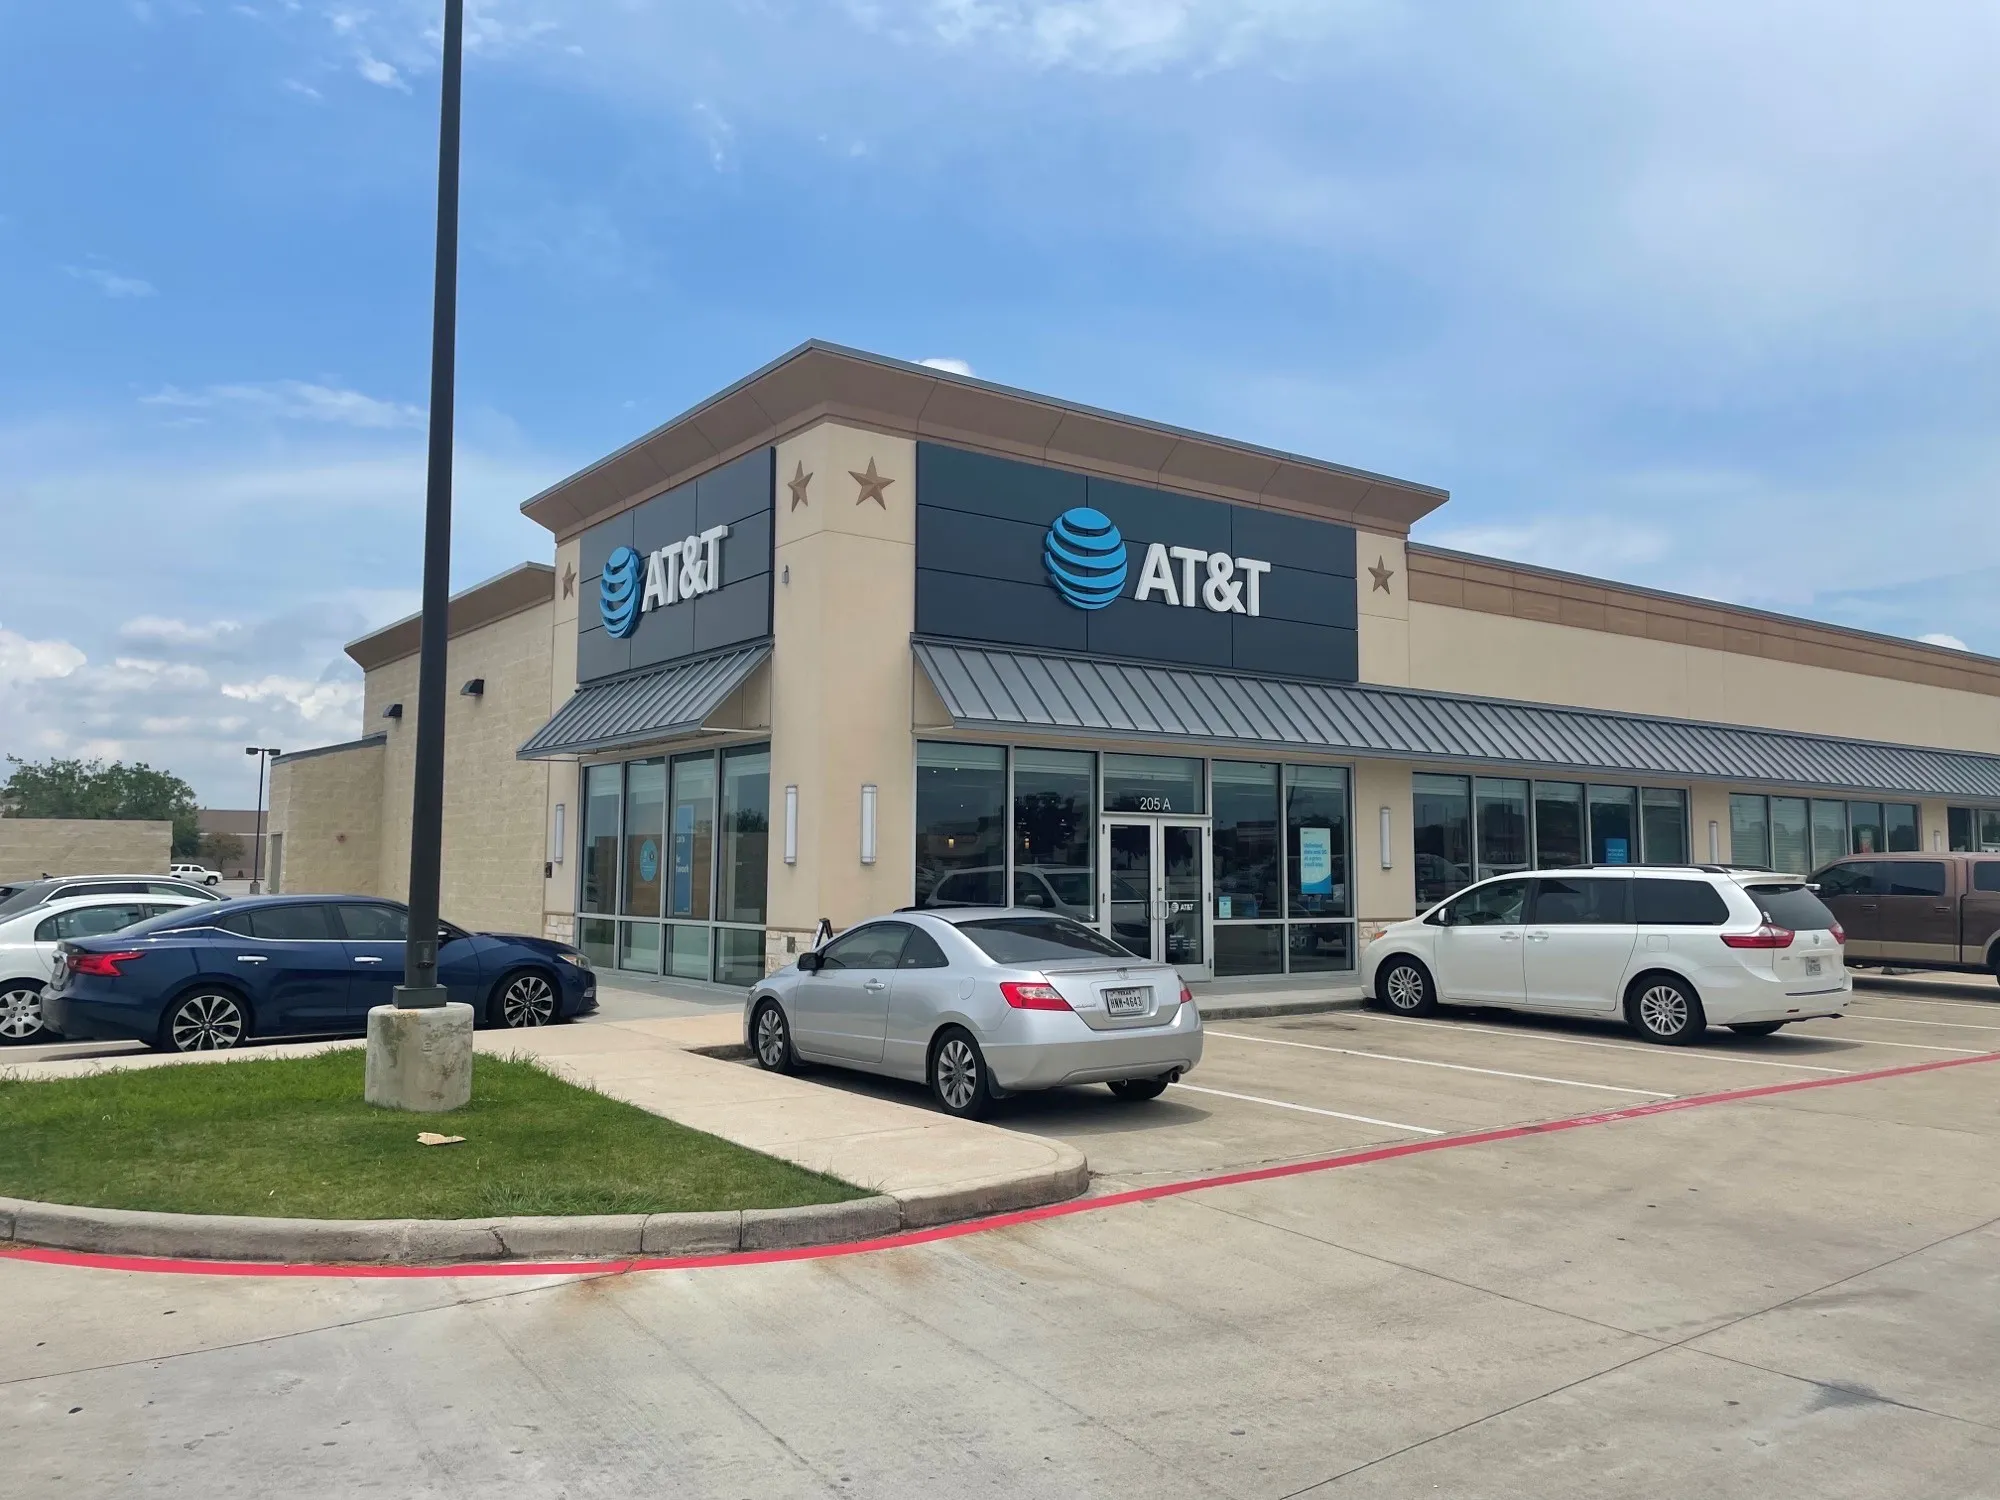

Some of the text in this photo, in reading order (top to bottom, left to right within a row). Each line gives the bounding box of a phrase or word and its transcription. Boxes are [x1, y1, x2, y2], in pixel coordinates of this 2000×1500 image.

[641, 525, 728, 612] AT&T
[1135, 543, 1271, 616] AT&T
[1140, 797, 1171, 810] 205 A
